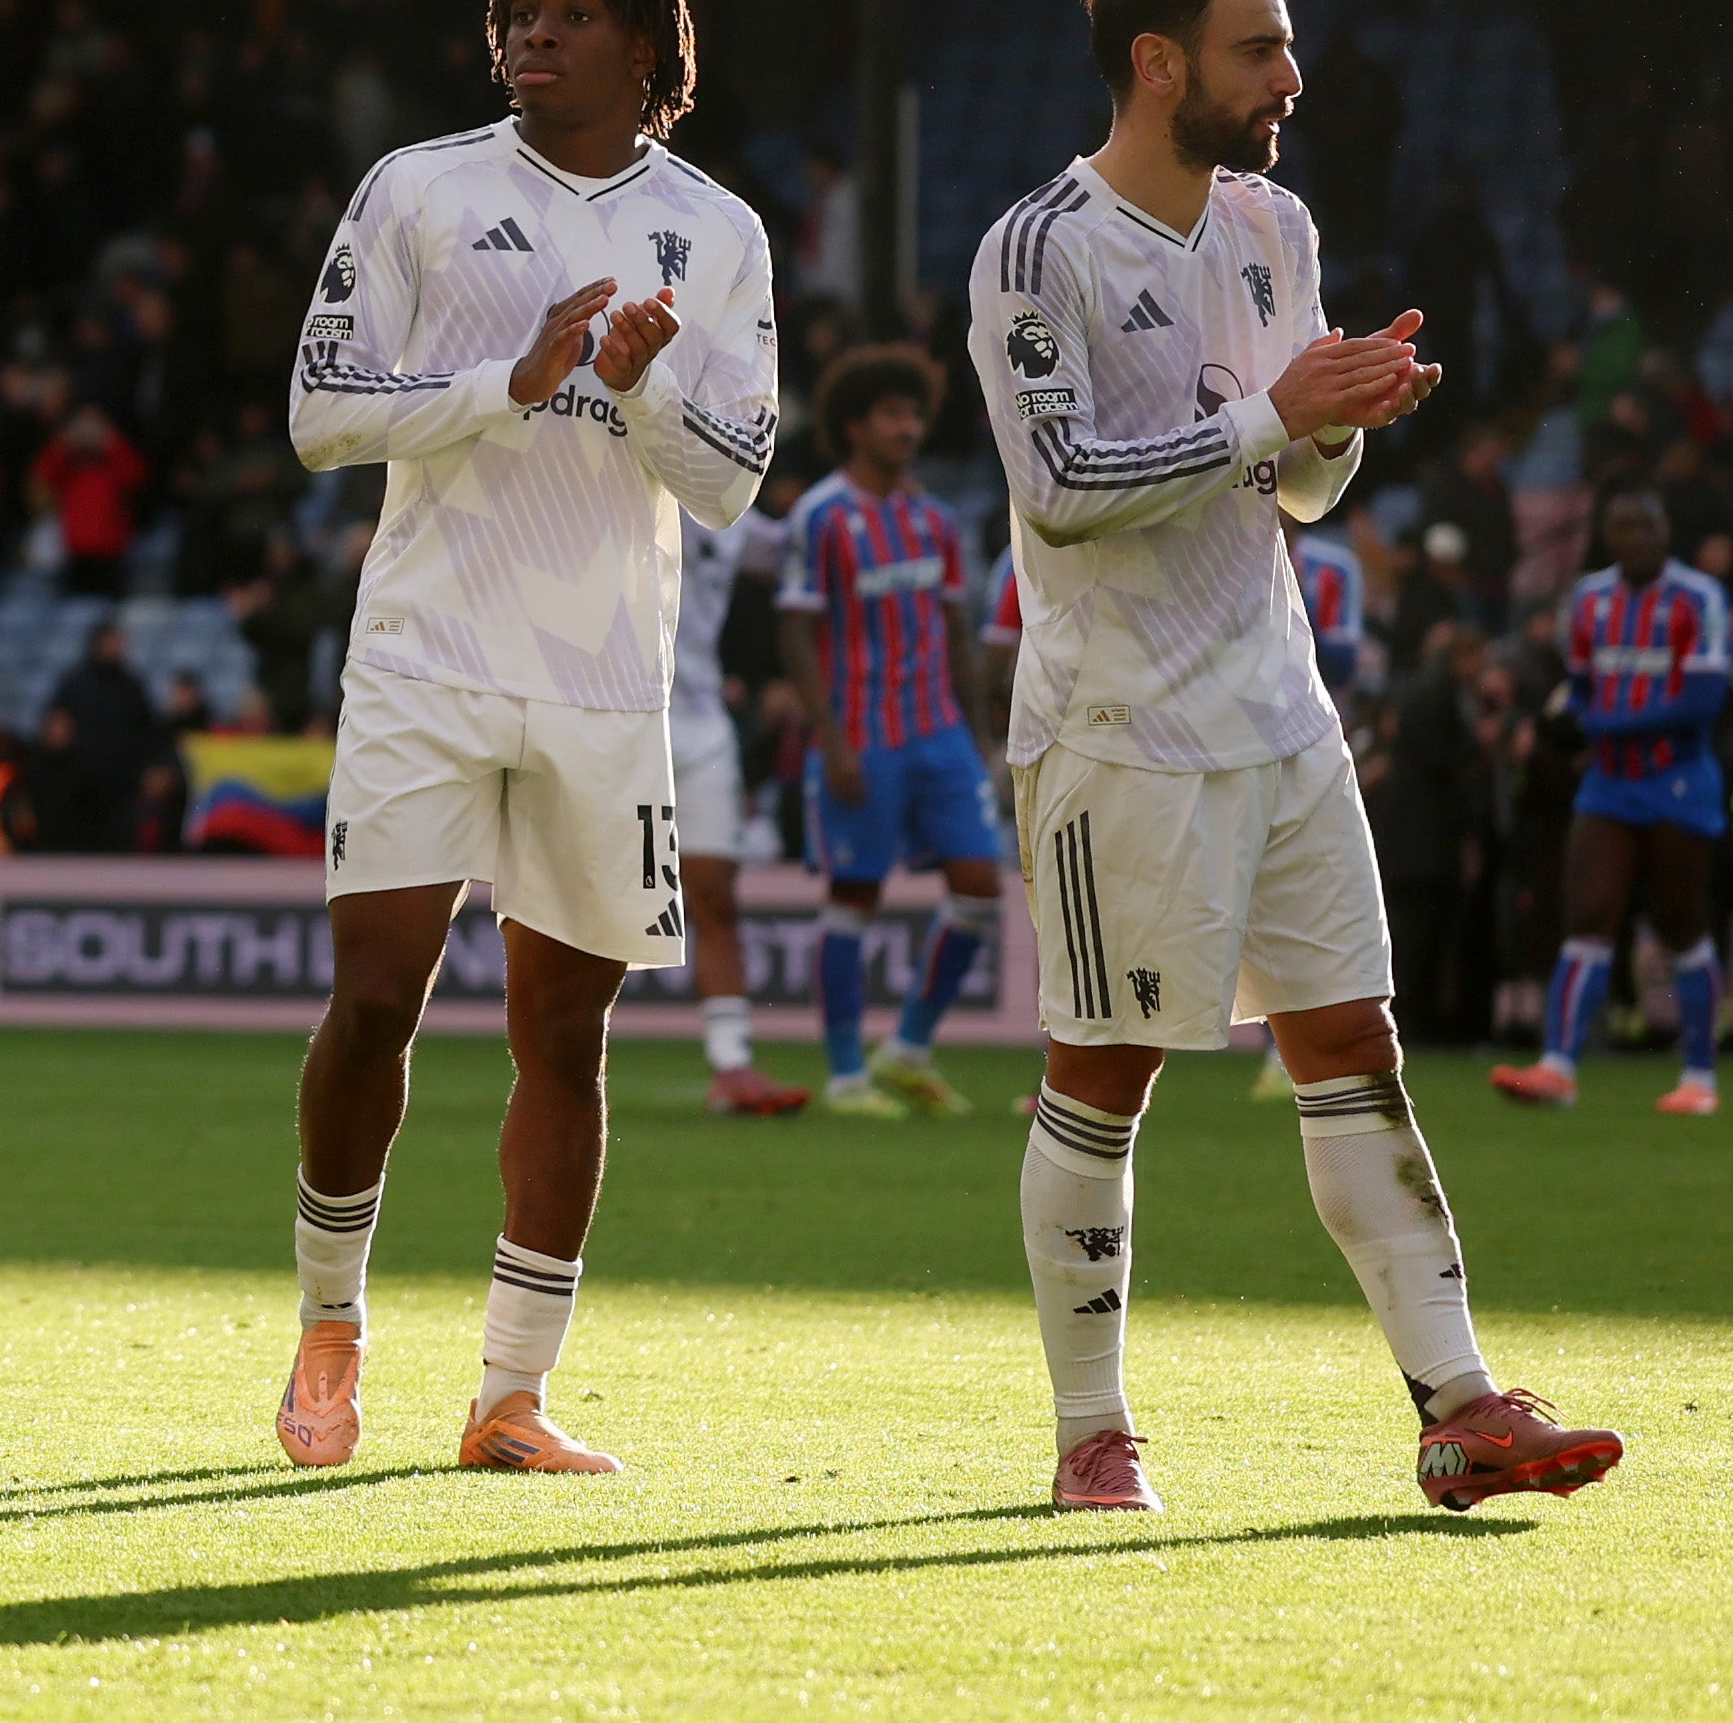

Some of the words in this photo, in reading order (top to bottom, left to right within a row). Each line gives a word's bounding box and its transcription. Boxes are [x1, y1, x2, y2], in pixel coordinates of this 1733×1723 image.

[314, 317, 349, 329] room
[310, 327, 353, 339] racism
[1031, 391, 1070, 403] room
[1033, 402, 1080, 414] racism
[4, 911, 298, 986] SOUTH
